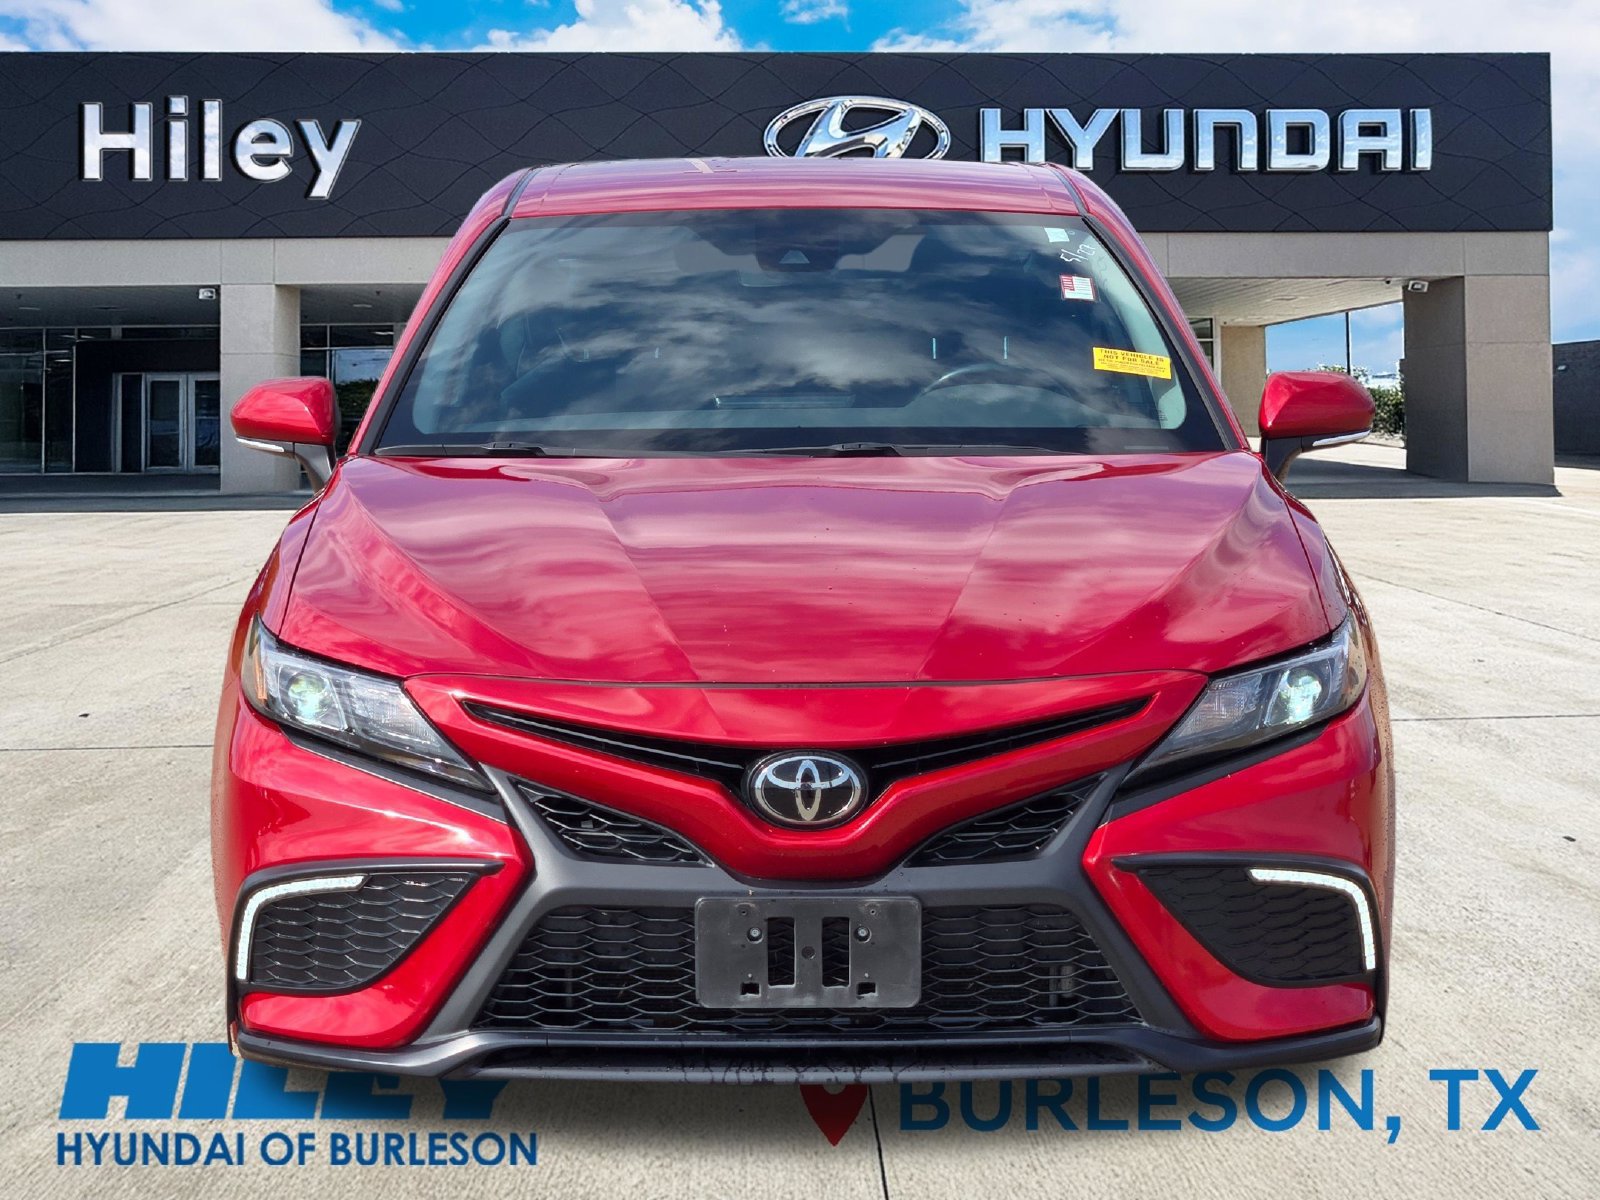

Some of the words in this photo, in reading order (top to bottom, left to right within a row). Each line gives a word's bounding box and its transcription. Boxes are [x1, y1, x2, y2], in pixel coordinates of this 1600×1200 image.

[80, 95, 361, 199] Hiley
[979, 107, 1432, 171] HYUNDAI
[1100, 348, 1118, 356] THIS
[1120, 351, 1154, 361] VEHICLE
[1140, 358, 1160, 366] SALE
